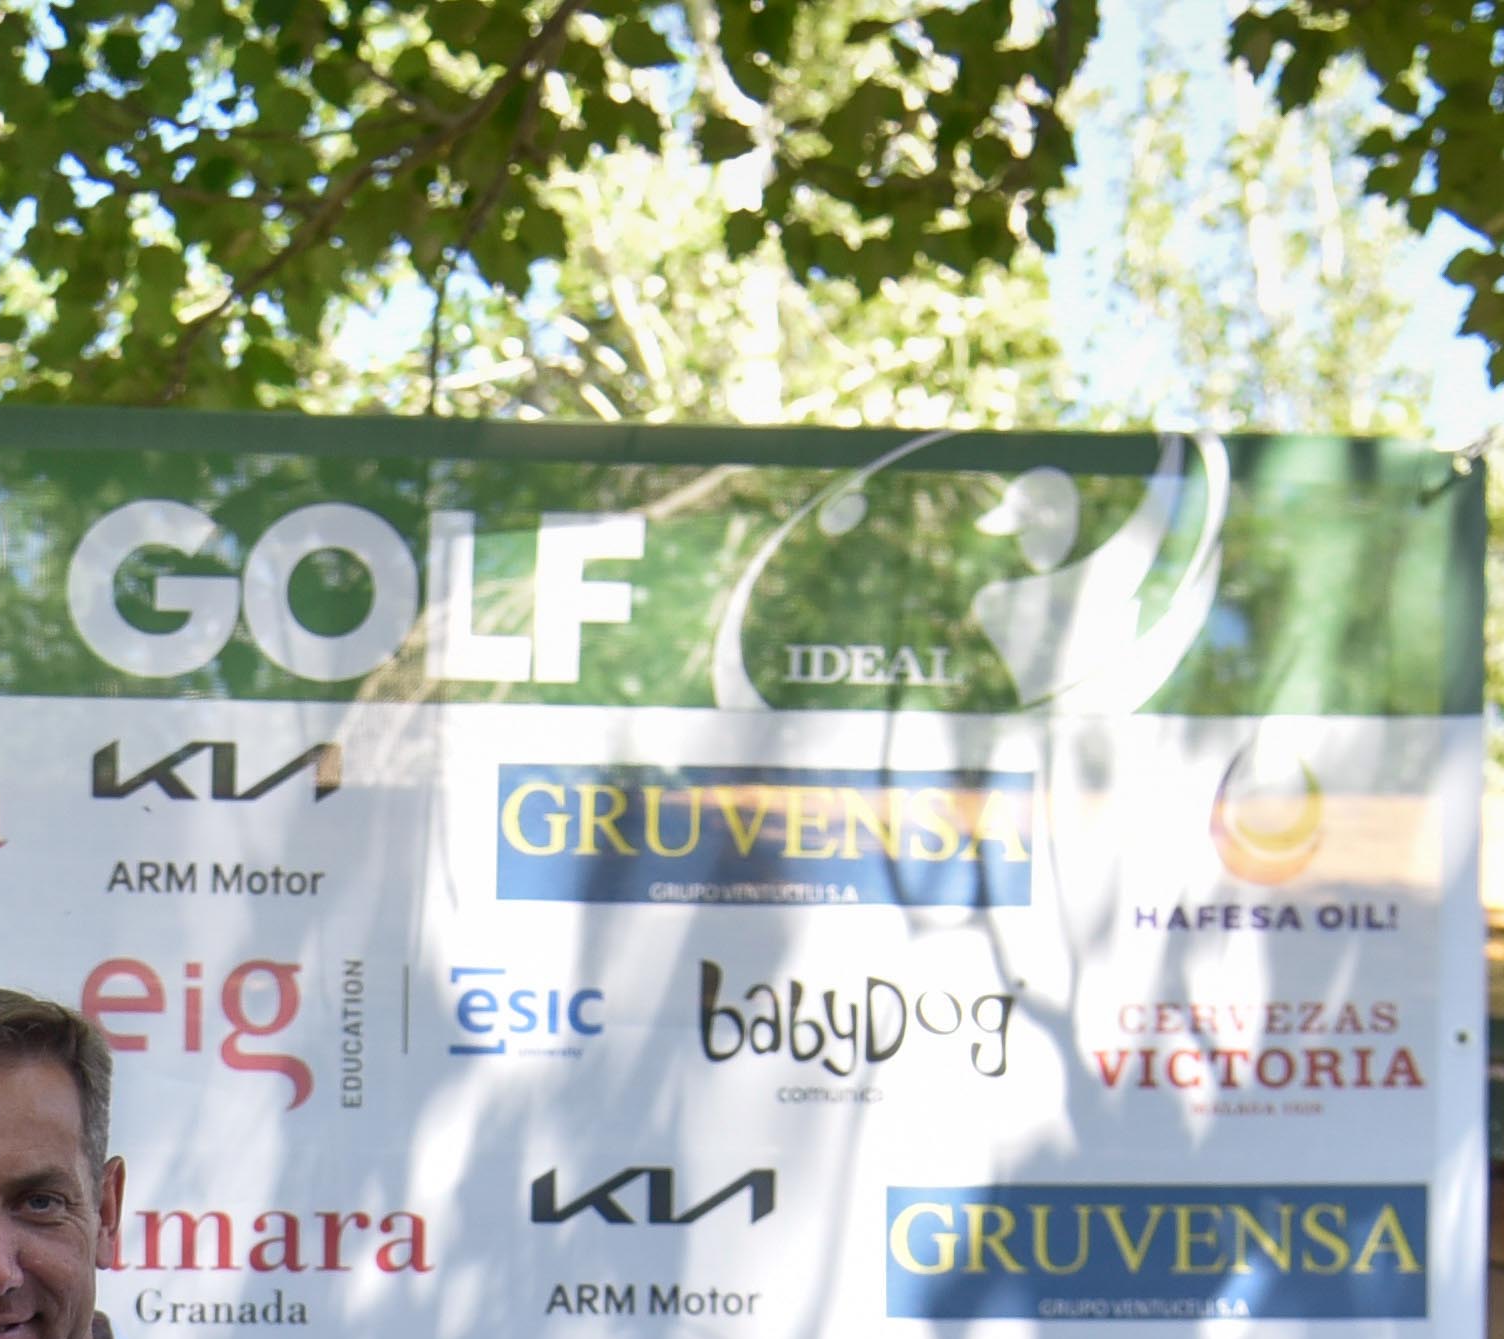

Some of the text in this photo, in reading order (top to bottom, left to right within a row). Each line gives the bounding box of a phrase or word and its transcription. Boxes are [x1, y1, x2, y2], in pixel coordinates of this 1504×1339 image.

[67, 499, 646, 684] GOLF
[782, 644, 963, 686] IDEAL
[500, 780, 1032, 862] GRUVENSA
[107, 862, 326, 897] ARM Motor
[1136, 905, 1400, 932] HAFESA OIL!
[80, 957, 313, 1111] eig
[341, 958, 365, 1110] EDUCATION
[700, 958, 1018, 1078] babyDog
[1119, 1001, 1399, 1035] CERVEZAS
[1096, 1047, 1426, 1090] VICTORIA
[110, 1208, 435, 1273] mara
[889, 1201, 1423, 1278] GRUVENSA
[134, 1289, 308, 1325] Granada
[545, 1284, 762, 1318] ARM Motor
